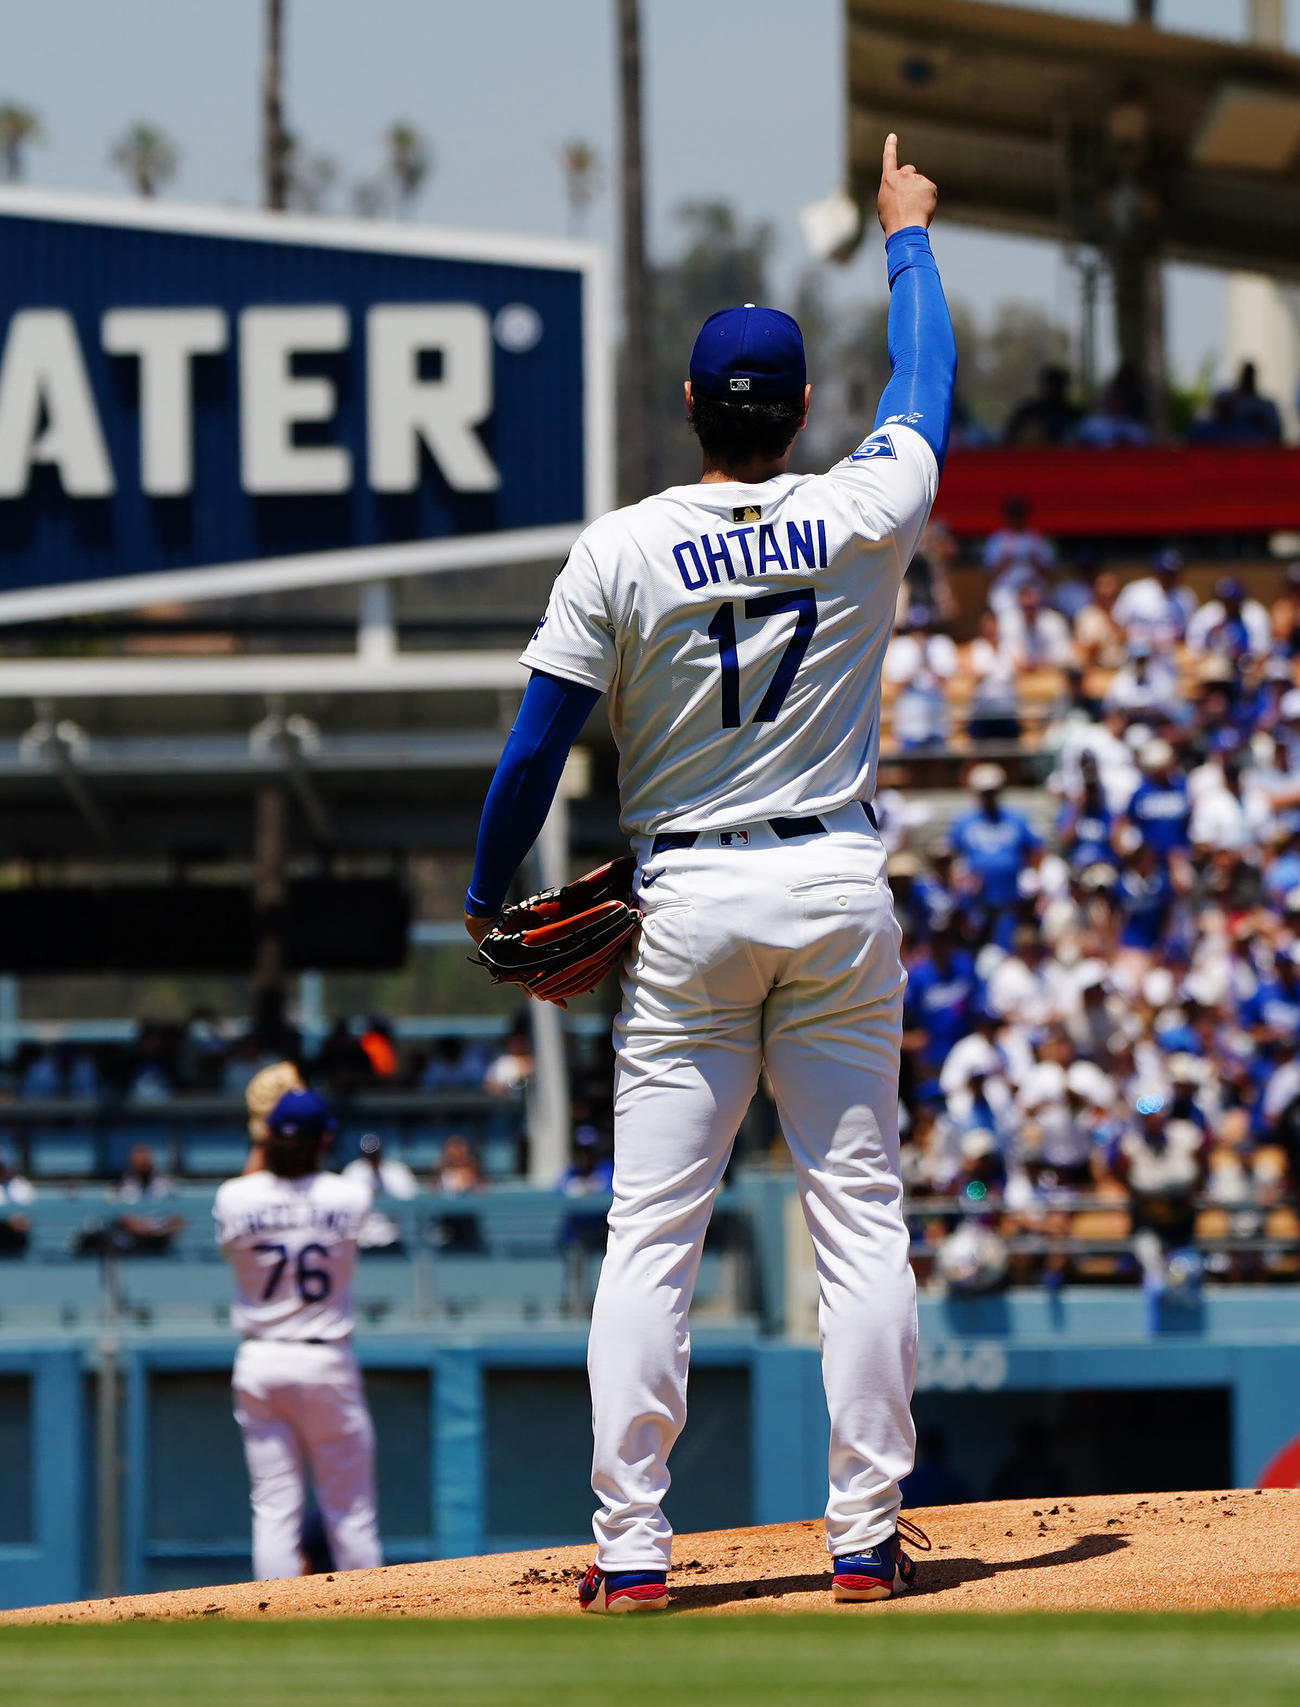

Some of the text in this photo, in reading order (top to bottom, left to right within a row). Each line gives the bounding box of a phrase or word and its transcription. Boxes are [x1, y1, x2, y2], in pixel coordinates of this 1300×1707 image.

[0, 303, 500, 497] ATER
[672, 519, 828, 591] OHTANI
[708, 588, 818, 728] 17
[253, 1243, 331, 1302] 76
